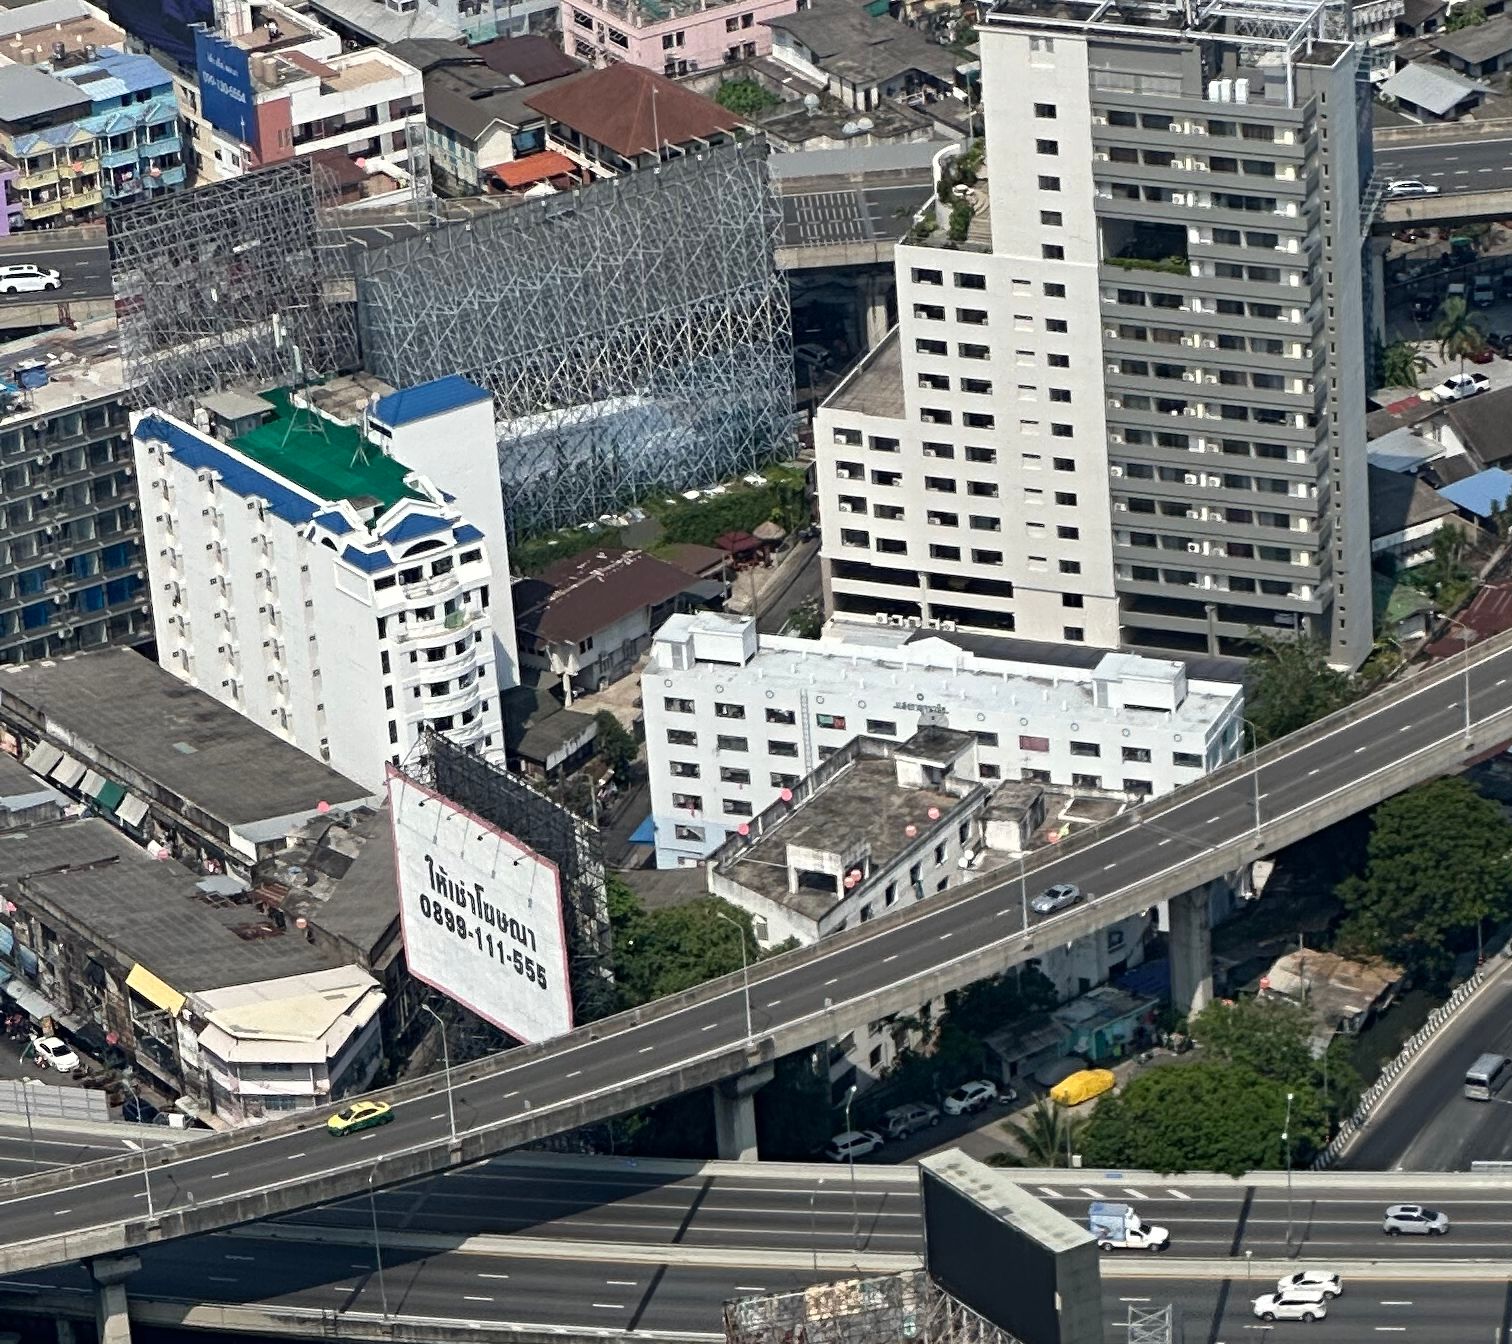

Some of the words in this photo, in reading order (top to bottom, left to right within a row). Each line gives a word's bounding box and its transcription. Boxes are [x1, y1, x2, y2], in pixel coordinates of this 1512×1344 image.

[420, 894, 547, 990] 0899-111-555
[424, 854, 537, 952] ให้เช่าโฆษณา
